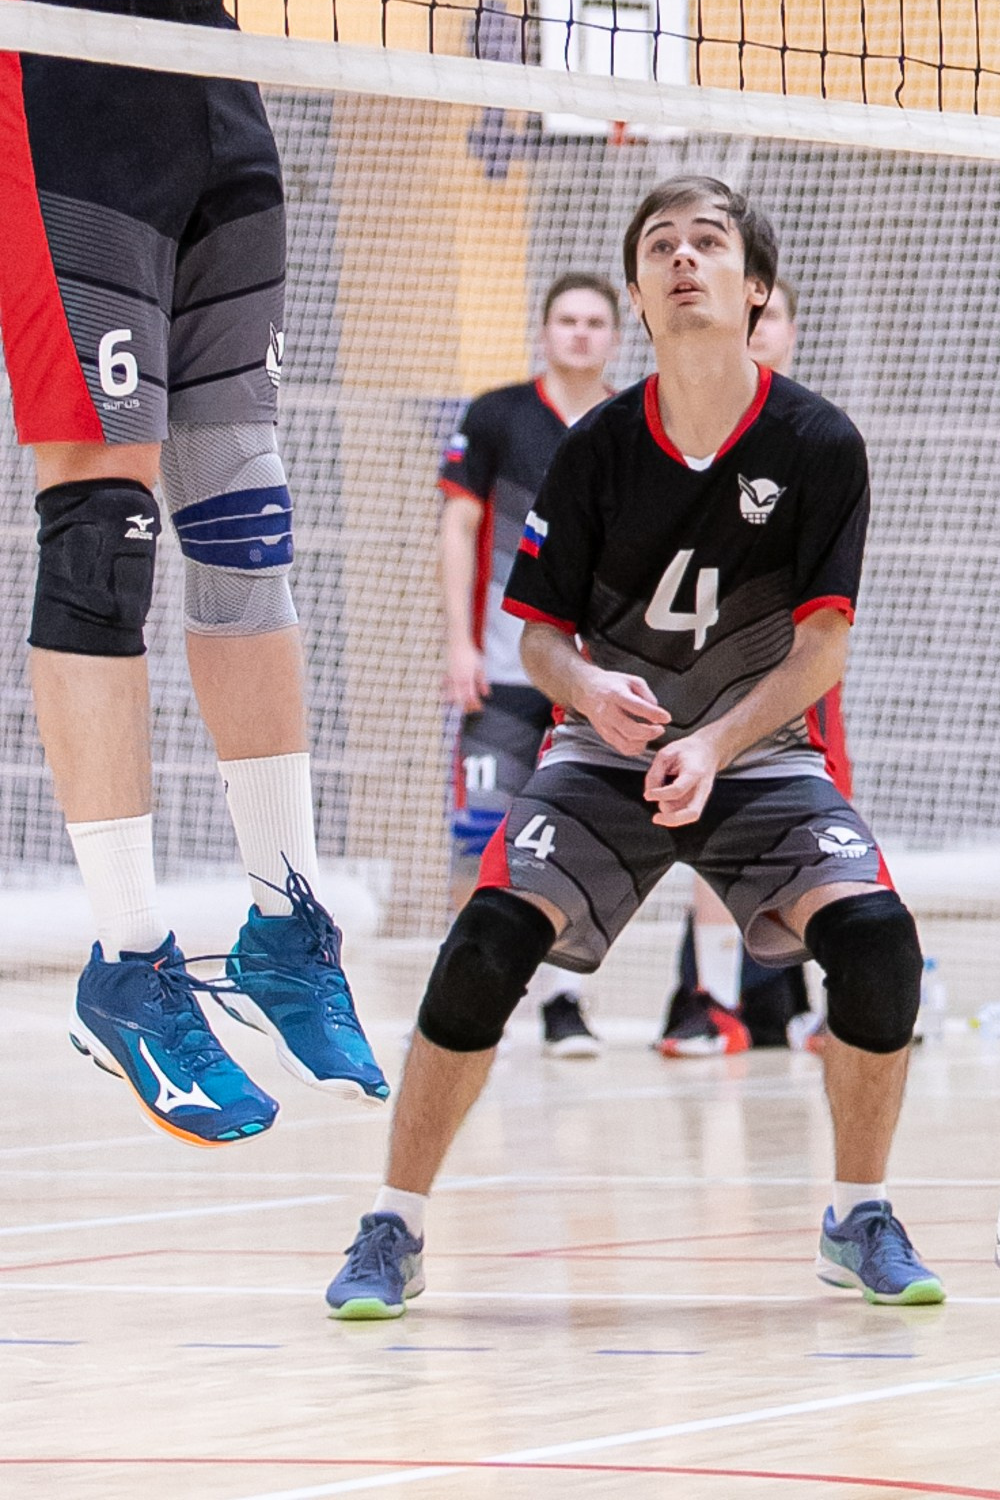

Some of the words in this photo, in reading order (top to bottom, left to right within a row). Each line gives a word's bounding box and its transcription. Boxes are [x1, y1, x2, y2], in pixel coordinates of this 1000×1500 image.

[98, 328, 138, 397] 6
[645, 548, 719, 650] 4
[462, 755, 497, 790] 11
[514, 815, 556, 859] 4
